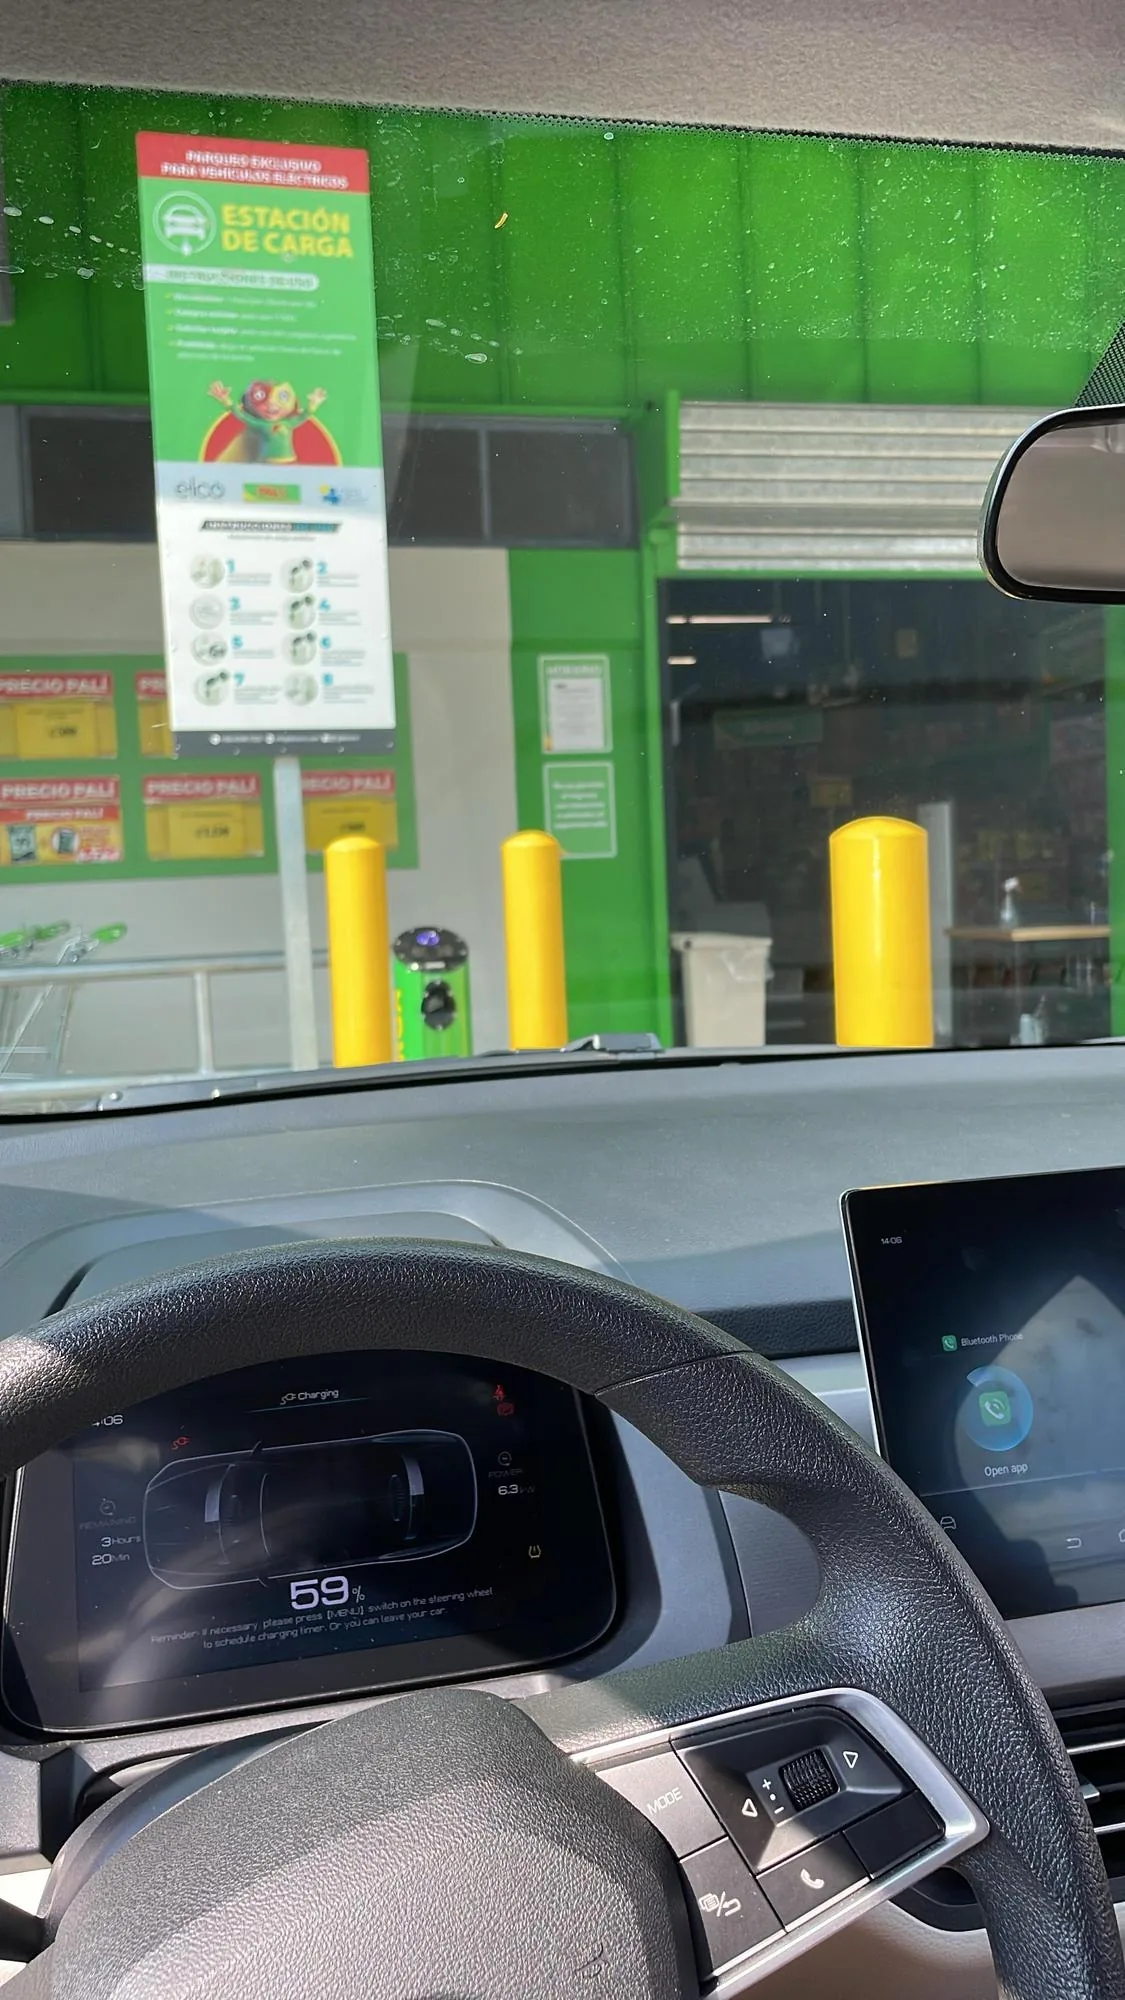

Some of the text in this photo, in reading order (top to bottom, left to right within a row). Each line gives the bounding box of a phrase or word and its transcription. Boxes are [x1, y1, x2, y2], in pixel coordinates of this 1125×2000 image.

[160, 161, 196, 176] PARA
[221, 203, 350, 234] ESTACIÓN
[222, 229, 354, 258] DE CARGA
[2, 783, 70, 800] PRECIO
[147, 780, 214, 796] PRECIO
[961, 1332, 1024, 1347] Bluetooth Phone
[297, 1389, 339, 1401] Charging
[984, 1463, 1028, 1478] Open app
[263, 1615, 293, 1629] please
[295, 1611, 323, 1625] press
[368, 1601, 399, 1613] switch
[400, 1599, 412, 1608] on
[413, 1595, 427, 1606] the
[428, 1590, 465, 1605] steering
[466, 1587, 494, 1599] wheel
[203, 1639, 213, 1649] to
[215, 1634, 256, 1648] schedule
[258, 1628, 299, 1643] charging
[329, 1621, 342, 1632] Or
[343, 1617, 361, 1632] you
[362, 1616, 380, 1627] can
[381, 1612, 406, 1624] leave
[407, 1609, 428, 1622] your
[646, 1786, 683, 1816] MODE
